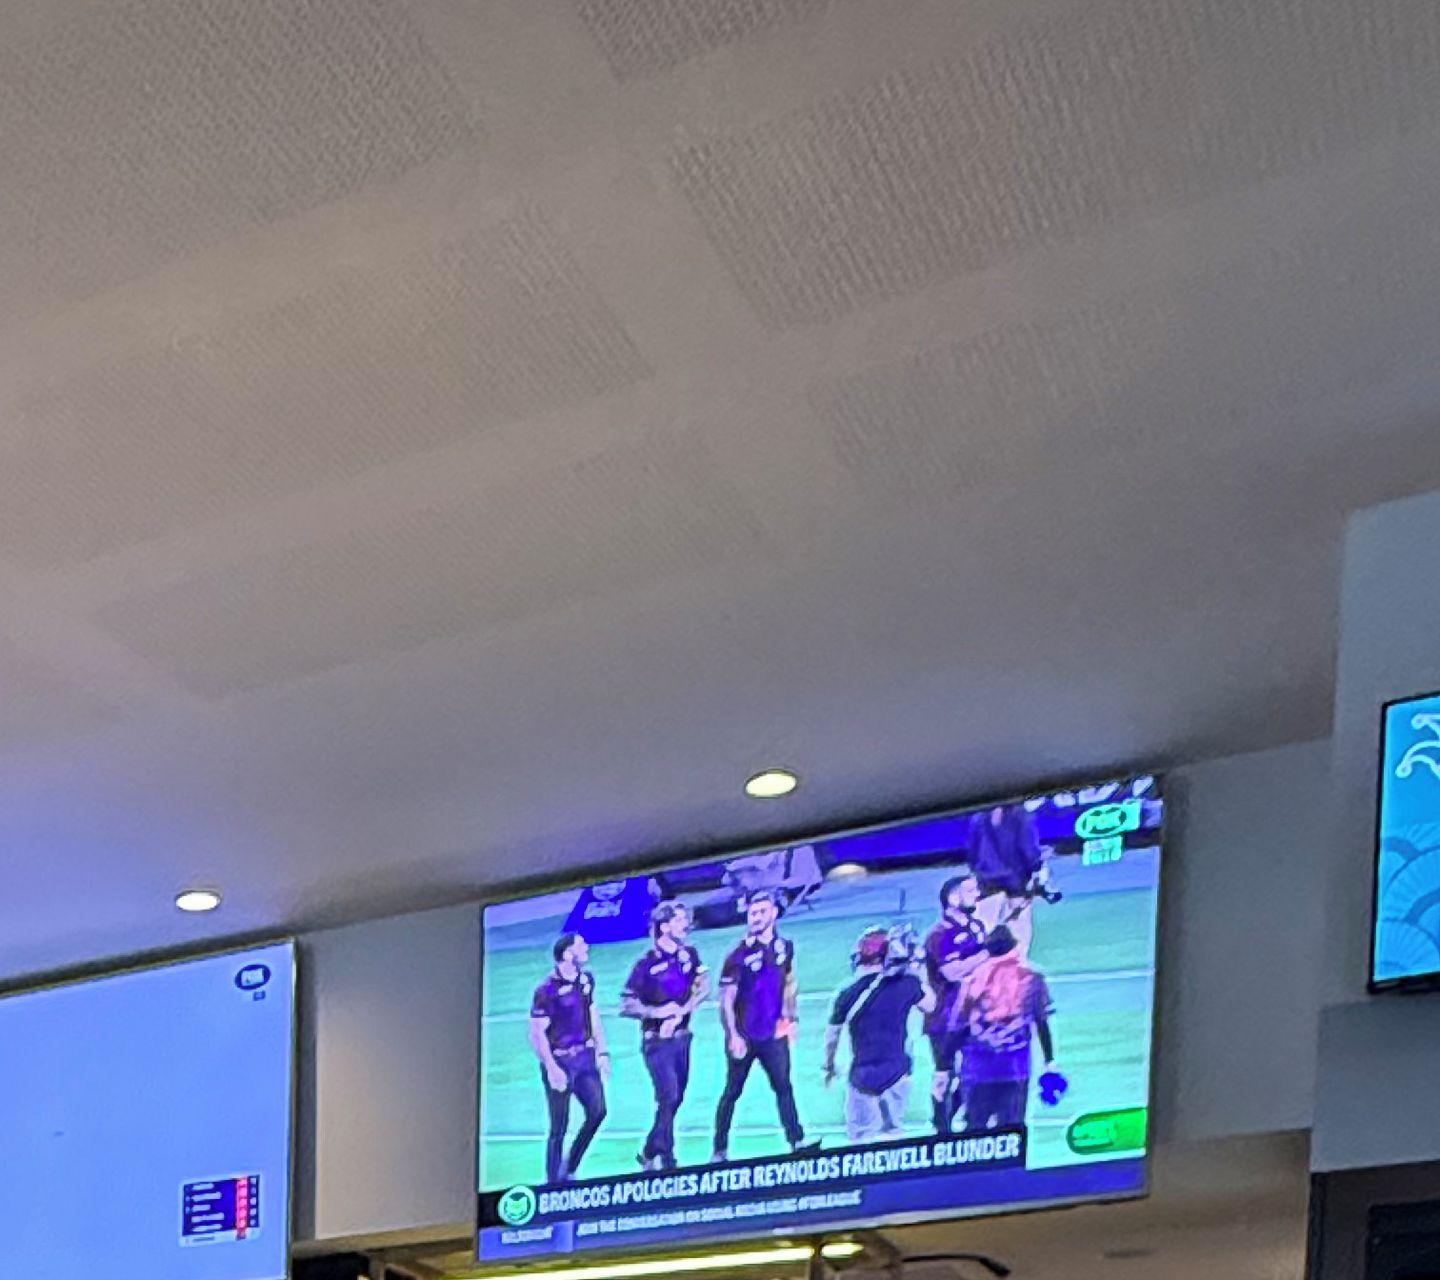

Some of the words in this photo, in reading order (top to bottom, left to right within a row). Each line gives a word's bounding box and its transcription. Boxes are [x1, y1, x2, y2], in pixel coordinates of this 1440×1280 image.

[538, 1185, 610, 1215] BRONCOS
[612, 1174, 698, 1205] APOLOGIES
[700, 1166, 752, 1195] AFTER
[753, 1157, 840, 1187] REYNOLDS
[842, 1145, 928, 1178] FAREWELL
[934, 1134, 1020, 1166] BLUNDER
